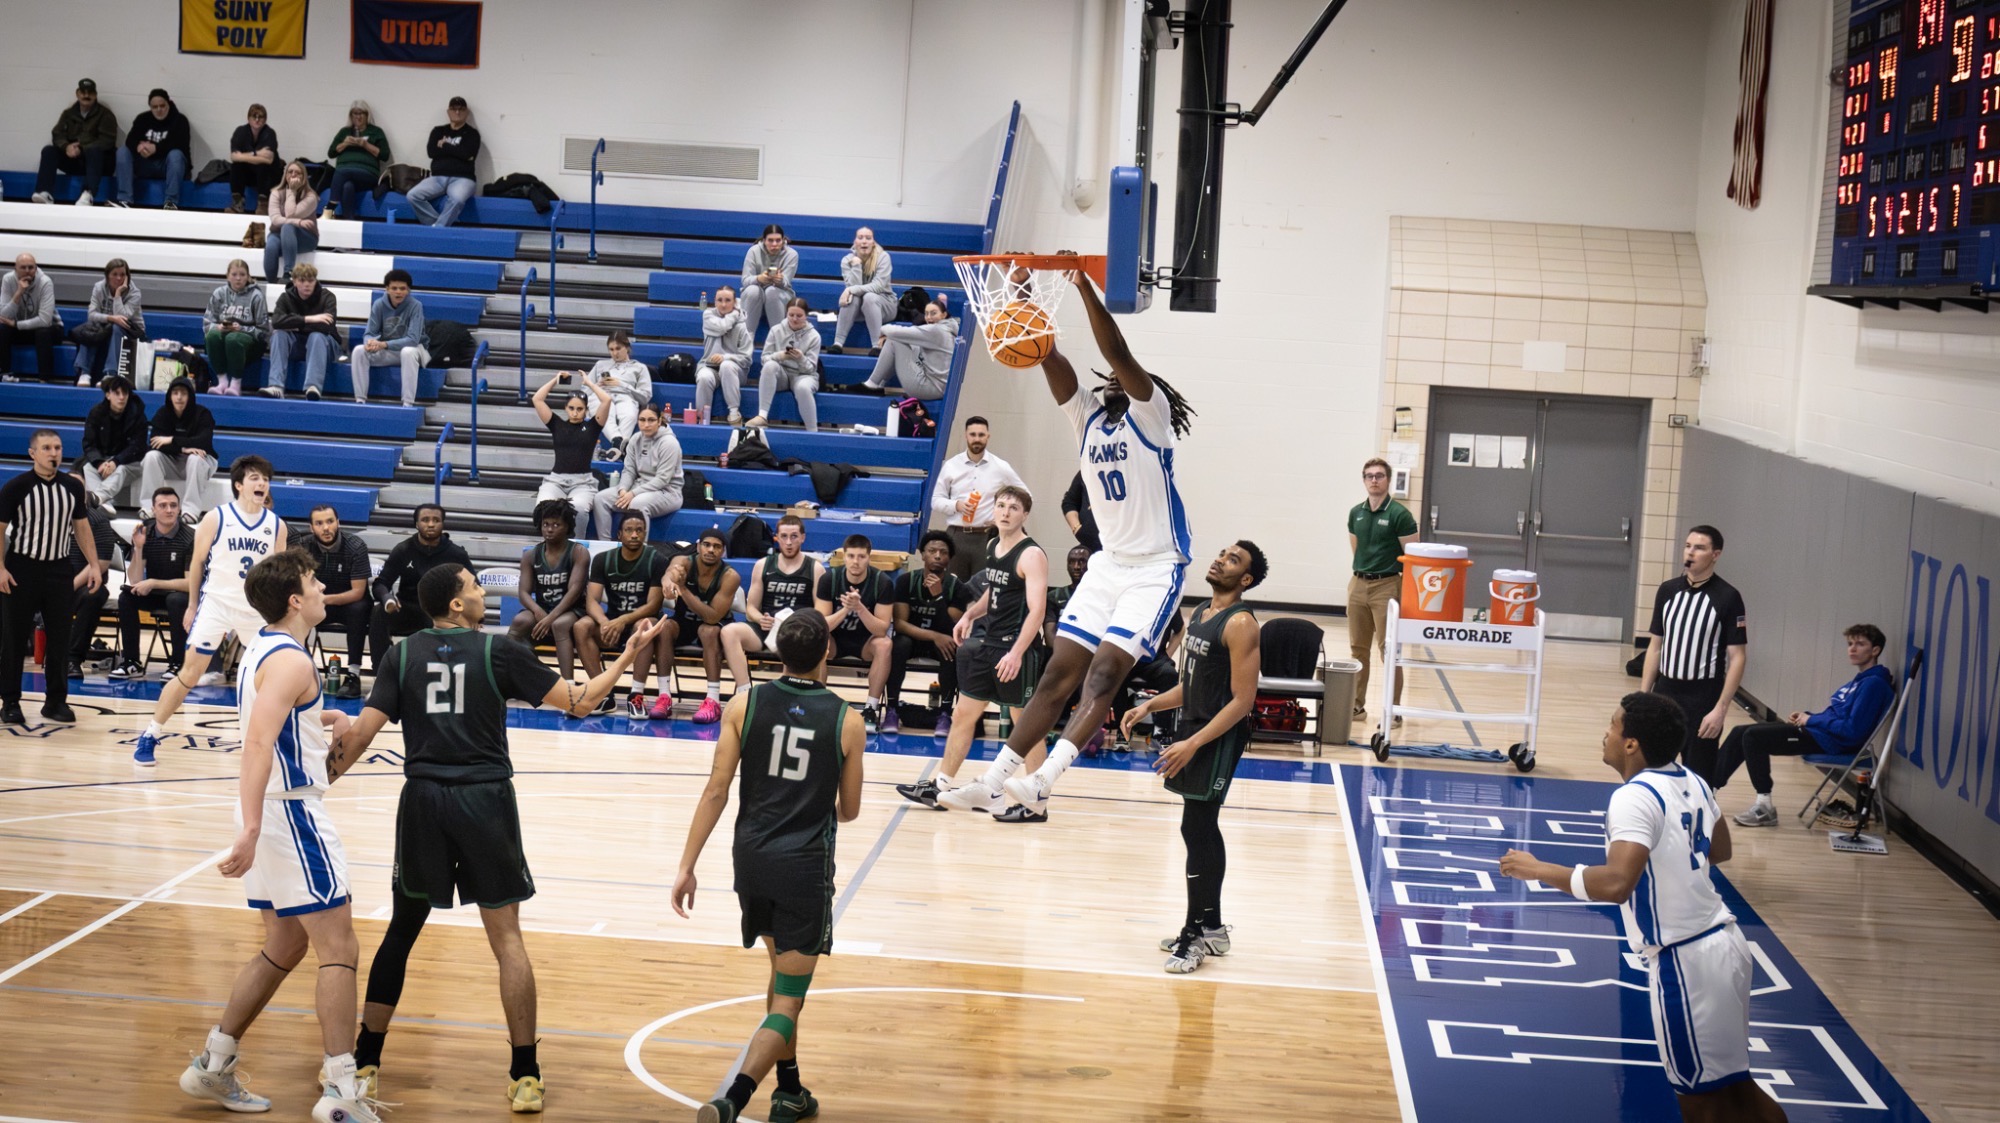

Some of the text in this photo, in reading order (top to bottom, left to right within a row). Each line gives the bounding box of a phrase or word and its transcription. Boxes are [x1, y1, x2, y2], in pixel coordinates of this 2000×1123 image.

[214, 0, 271, 22] SUNY
[217, 26, 268, 49] POLY
[380, 18, 449, 46] UTICA
[1097, 469, 1127, 502] 10
[228, 537, 269, 556] HAWKS
[238, 555, 254, 580] 3
[536, 571, 568, 586] SAGE
[610, 581, 645, 593] SAGE
[767, 581, 807, 595] SAGE
[1422, 570, 1442, 592] G
[542, 588, 564, 603] 25
[616, 595, 639, 612] 32
[991, 587, 1001, 609] 5
[1422, 626, 1513, 645] GATORADE
[329, 665, 338, 675] G
[426, 662, 466, 714] 21
[767, 724, 816, 781] 15
[1213, 777, 1226, 791] S
